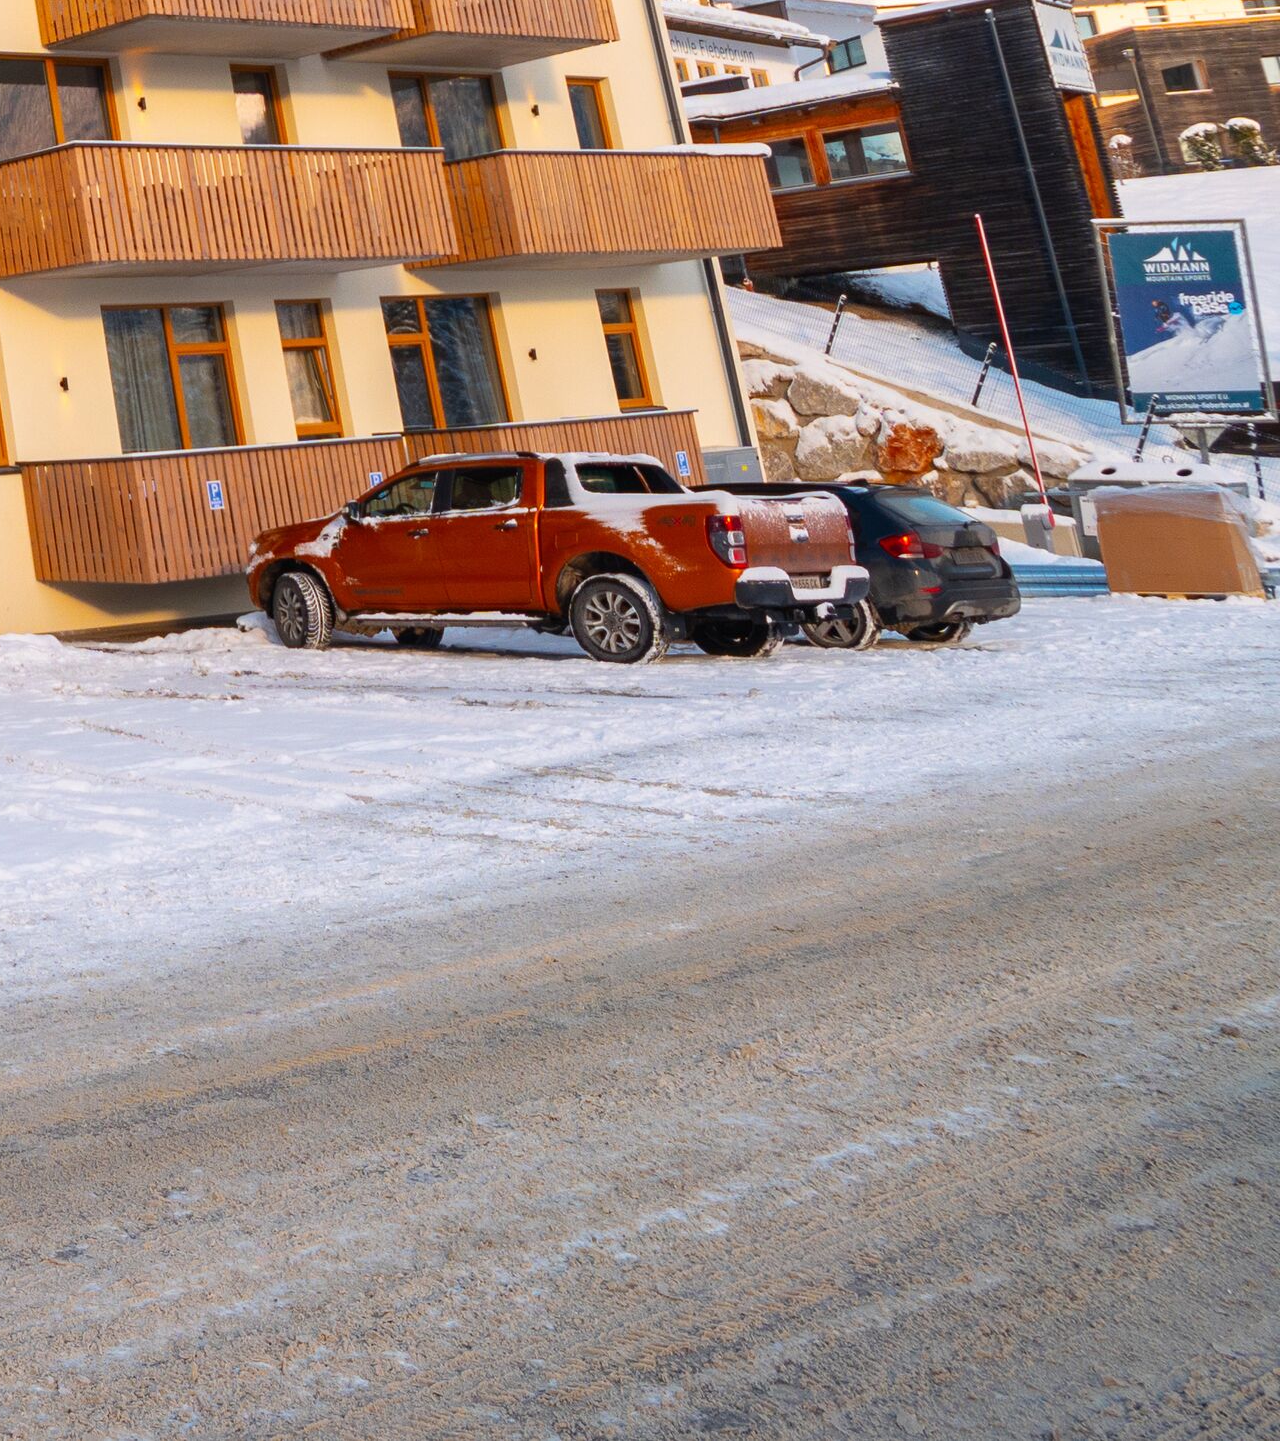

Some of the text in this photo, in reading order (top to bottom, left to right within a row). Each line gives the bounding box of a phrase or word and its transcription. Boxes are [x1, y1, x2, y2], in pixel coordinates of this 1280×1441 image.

[699, 39, 756, 64] Fieberbrunn
[1143, 262, 1210, 273] WIDMANN
[1184, 274, 1212, 282] SPORTS
[1178, 291, 1235, 306] freeride
[1192, 301, 1229, 315] base
